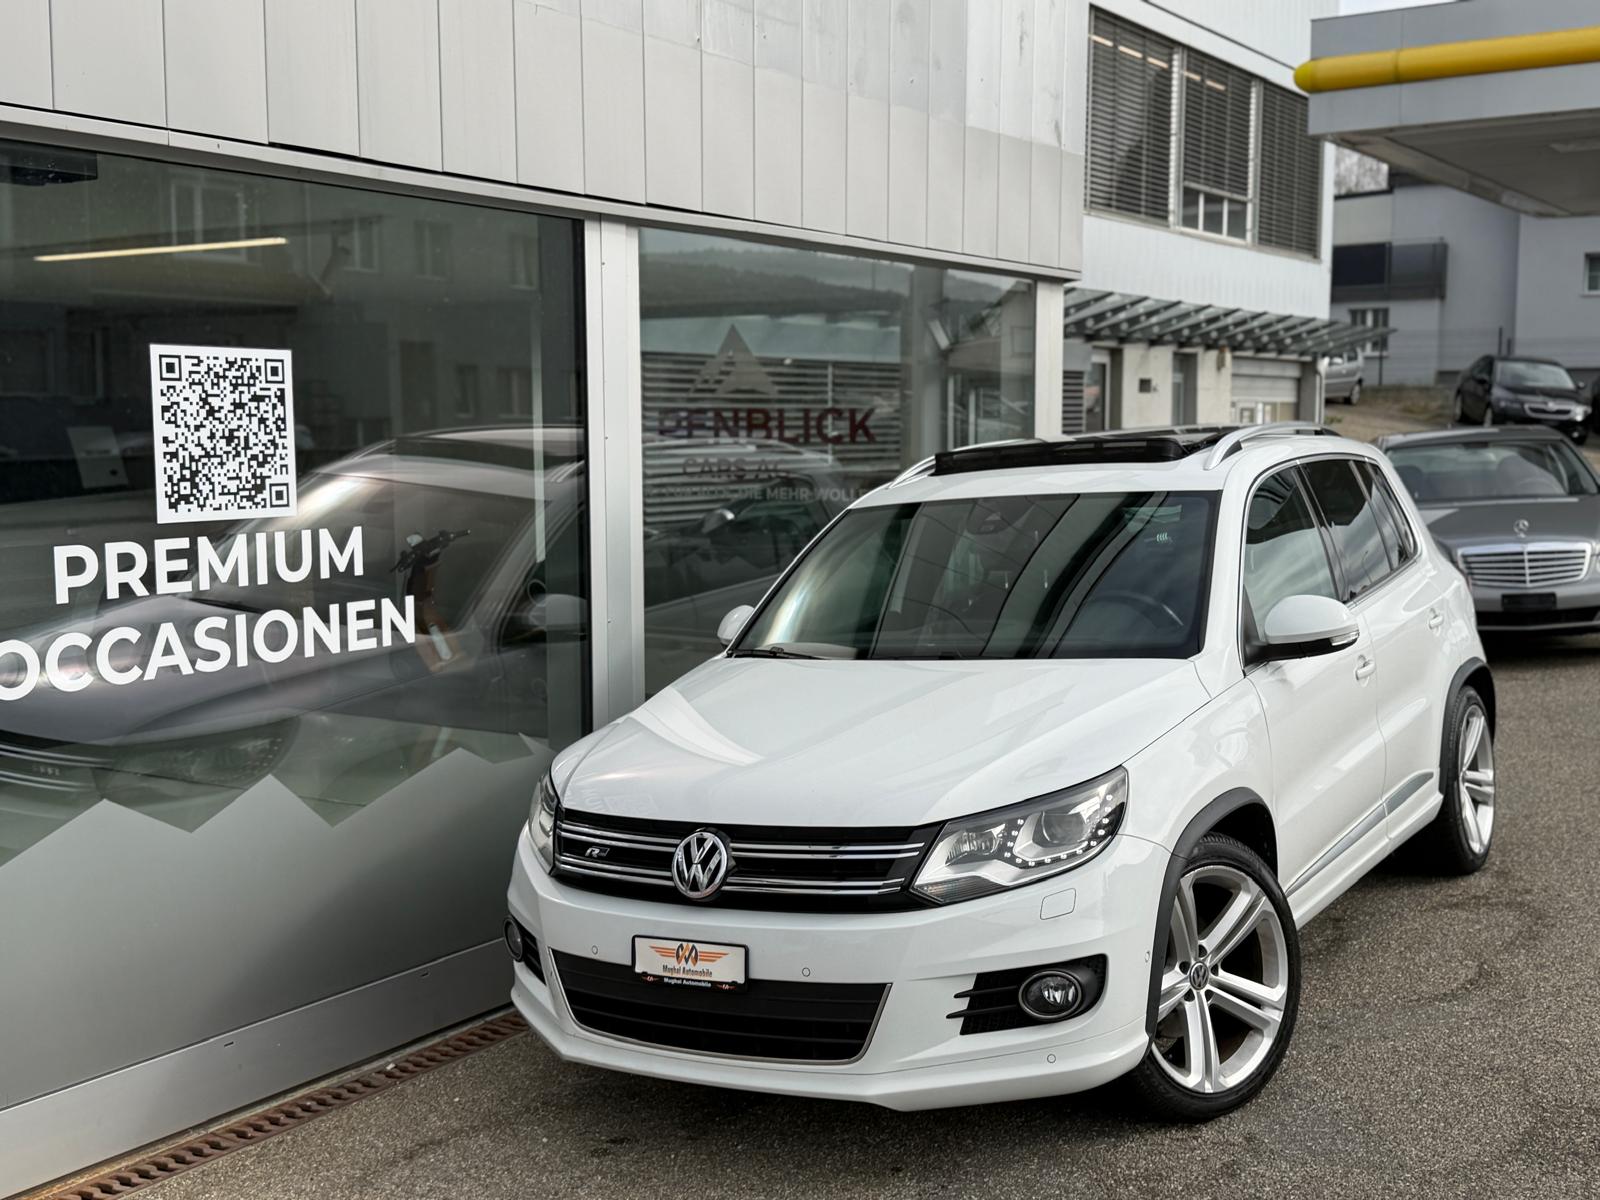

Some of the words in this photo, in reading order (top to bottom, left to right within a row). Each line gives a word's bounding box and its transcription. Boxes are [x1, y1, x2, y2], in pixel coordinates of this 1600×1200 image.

[766, 487, 809, 501] MEHR
[53, 526, 364, 604] PREMIUM
[0, 595, 416, 701] OCCASIONEN
[682, 966, 712, 977] Automobile
[682, 979, 712, 988] Automobile
